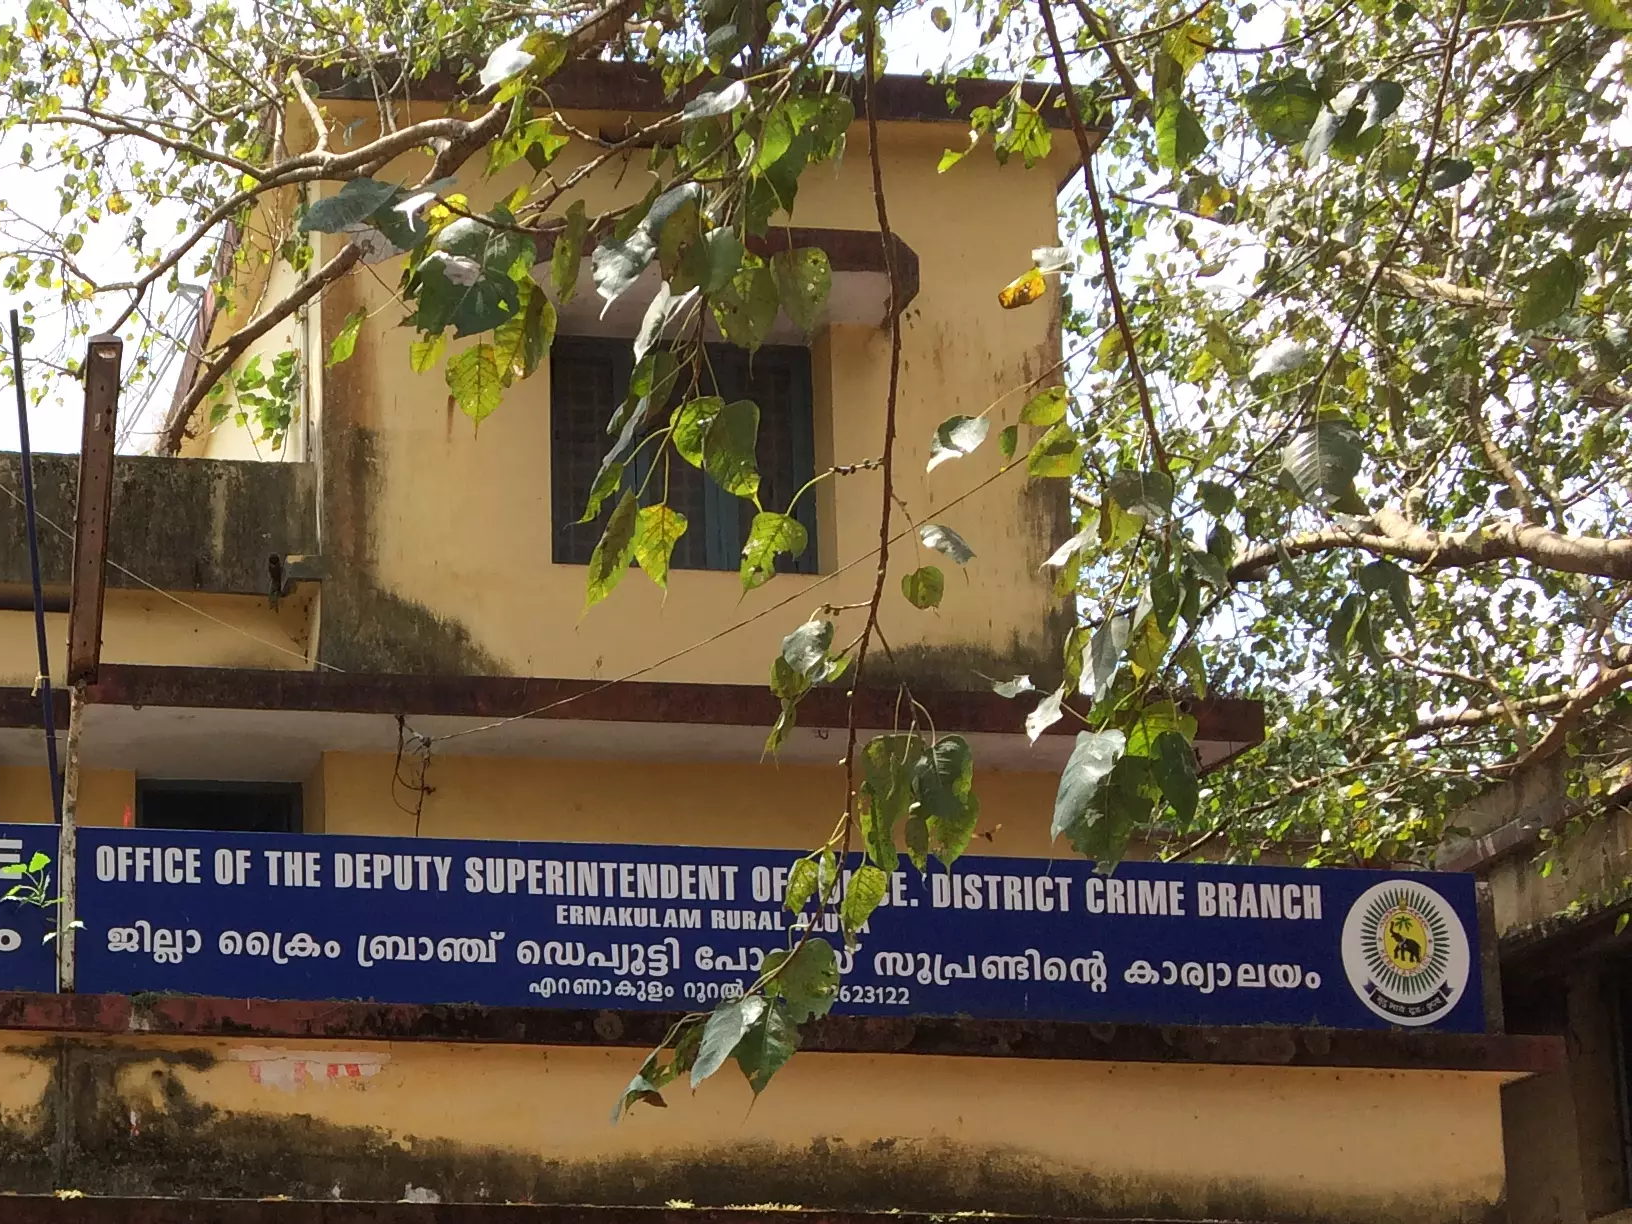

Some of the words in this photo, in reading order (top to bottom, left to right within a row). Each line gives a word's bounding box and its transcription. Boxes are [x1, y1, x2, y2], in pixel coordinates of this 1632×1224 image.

[96, 845, 202, 885] OFFICE
[215, 848, 252, 886] OF
[264, 850, 321, 888] THE
[334, 853, 452, 892] DEPUTY
[465, 857, 739, 902] SUPERINTENDENT
[932, 873, 1073, 913] DISTRICT
[1085, 877, 1186, 917] CRIME
[1197, 881, 1323, 920] BRANCH
[556, 904, 702, 929] ERNAKULAM
[711, 908, 786, 932] RURAL
[107, 919, 203, 965] ജില്ലാ
[218, 930, 341, 966] ക്രൈം
[516, 936, 681, 977] ഡെപ്യൂട്ടി
[1123, 958, 1323, 995] കാര്യാലയം
[528, 977, 675, 1003] എറണാകുളം
